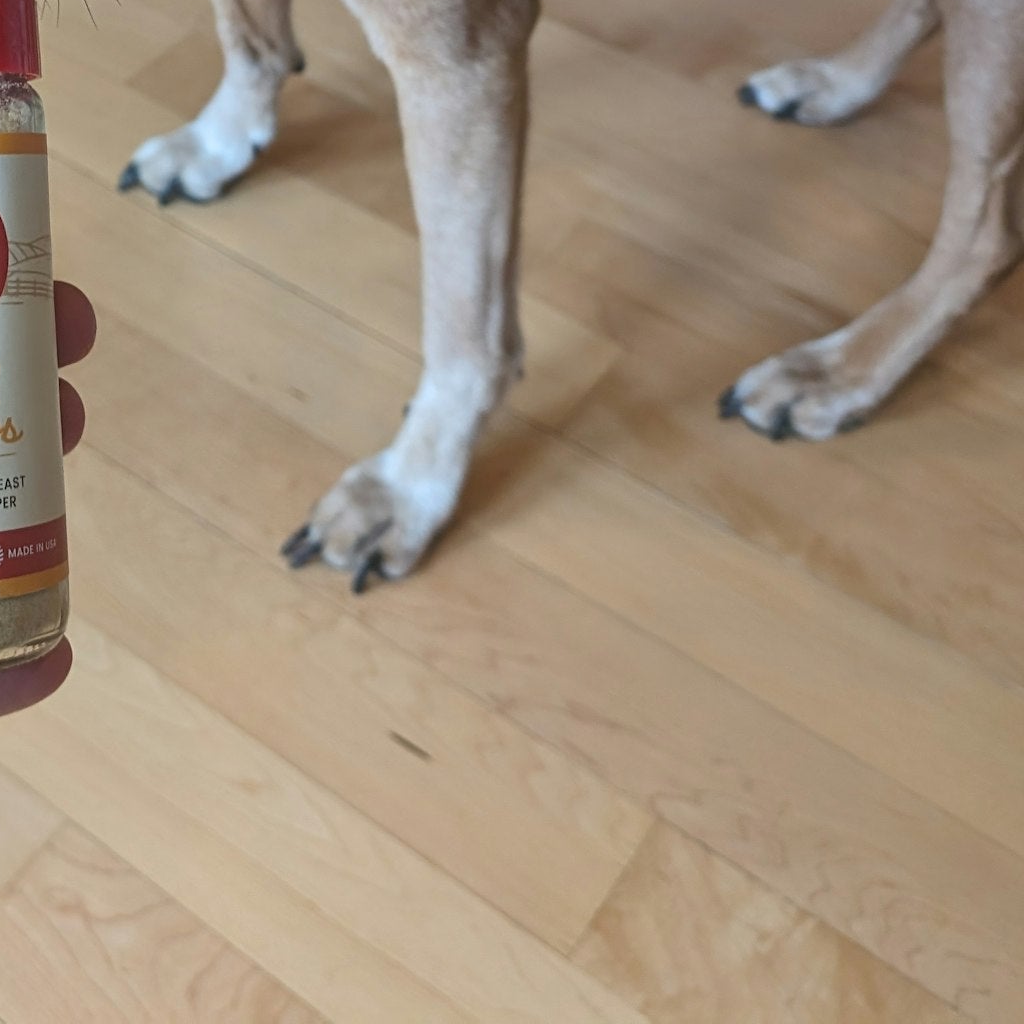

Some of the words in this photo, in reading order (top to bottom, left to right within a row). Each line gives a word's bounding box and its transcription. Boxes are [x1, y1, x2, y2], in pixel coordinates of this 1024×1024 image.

[7, 544, 34, 559] MADE
[36, 542, 44, 553] IN
[45, 537, 57, 551] USA
